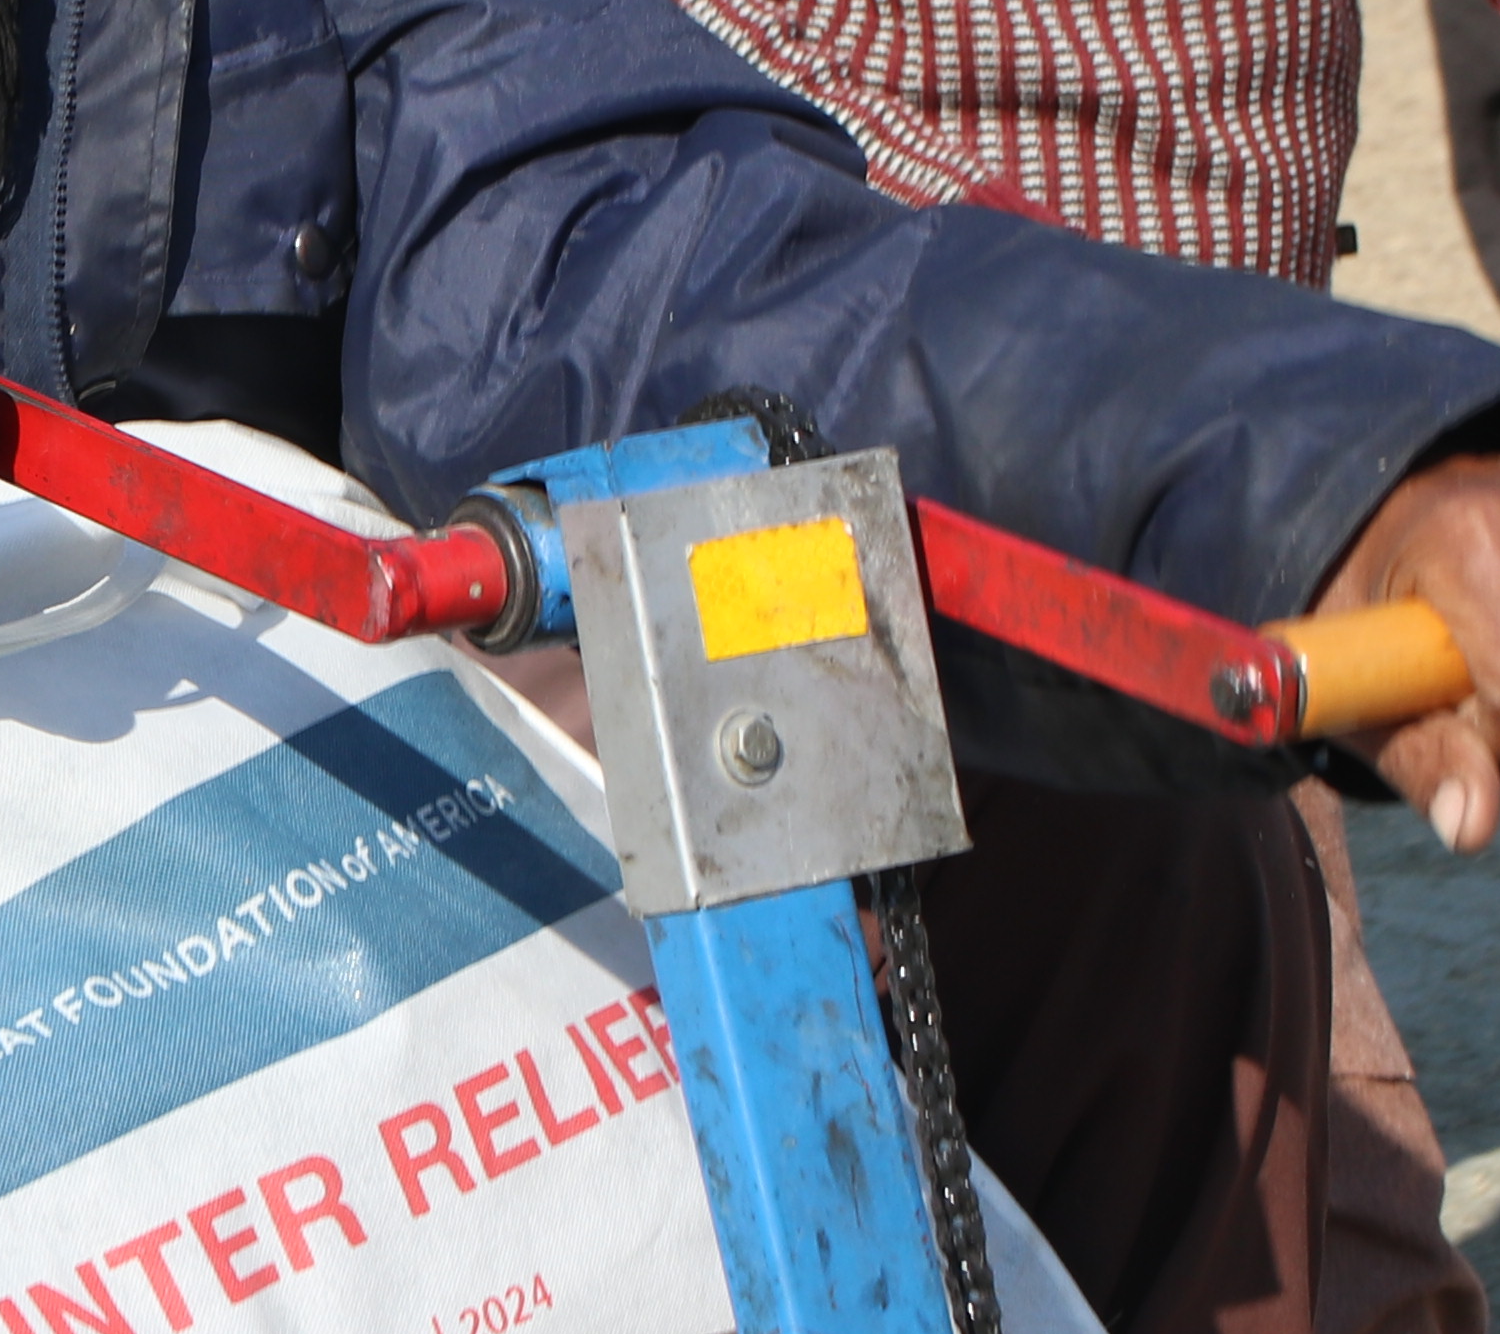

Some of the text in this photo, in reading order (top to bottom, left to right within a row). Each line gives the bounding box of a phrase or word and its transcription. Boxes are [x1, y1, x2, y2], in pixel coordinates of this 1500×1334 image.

[53, 859, 349, 1026] FOUNDATION
[341, 835, 378, 883] of
[376, 773, 516, 867] AMERICA
